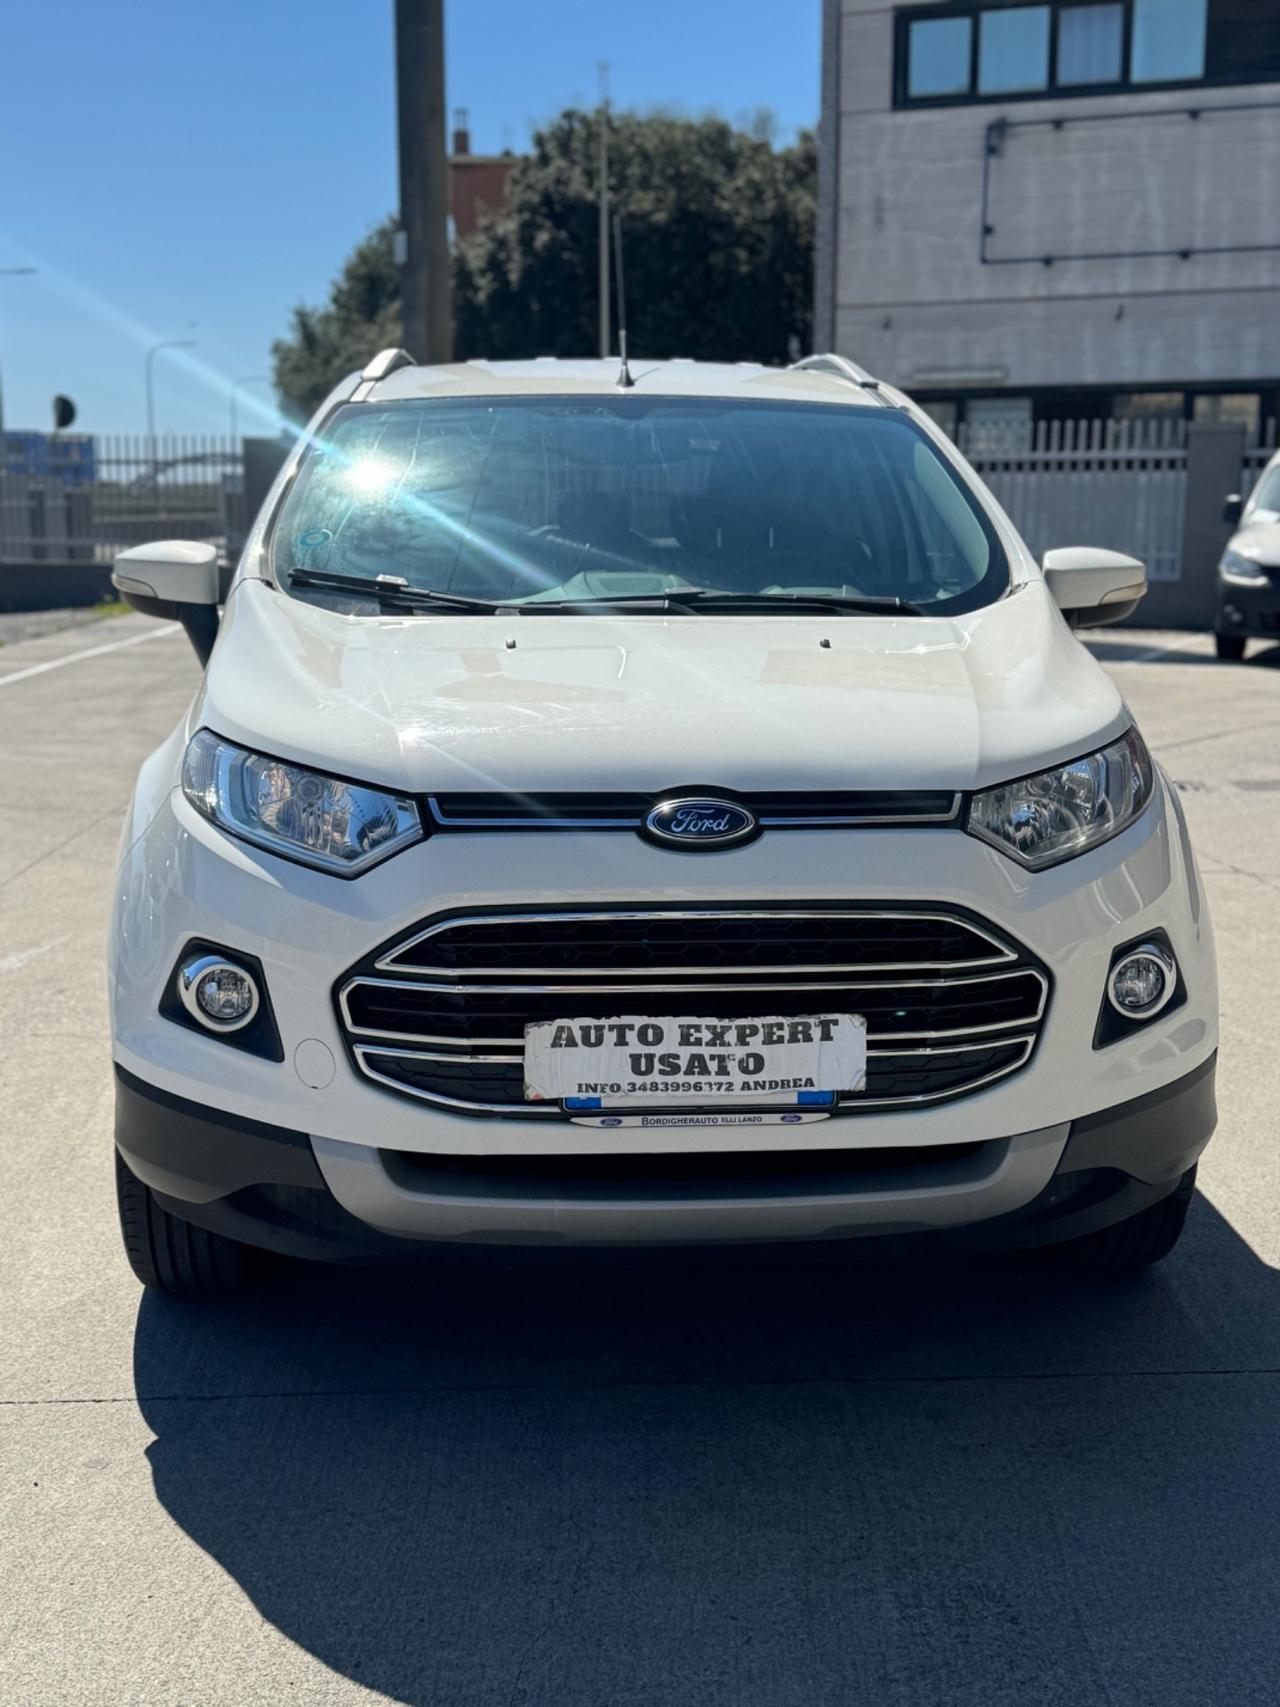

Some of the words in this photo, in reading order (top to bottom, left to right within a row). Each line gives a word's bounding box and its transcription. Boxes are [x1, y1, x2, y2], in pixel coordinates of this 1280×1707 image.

[671, 808, 731, 833] Ford
[550, 1023, 665, 1048] AUTO
[678, 1019, 839, 1047] EXPERT
[629, 1052, 765, 1077] USATO
[577, 1082, 621, 1094] INFO
[740, 1077, 815, 1091] ANDREA
